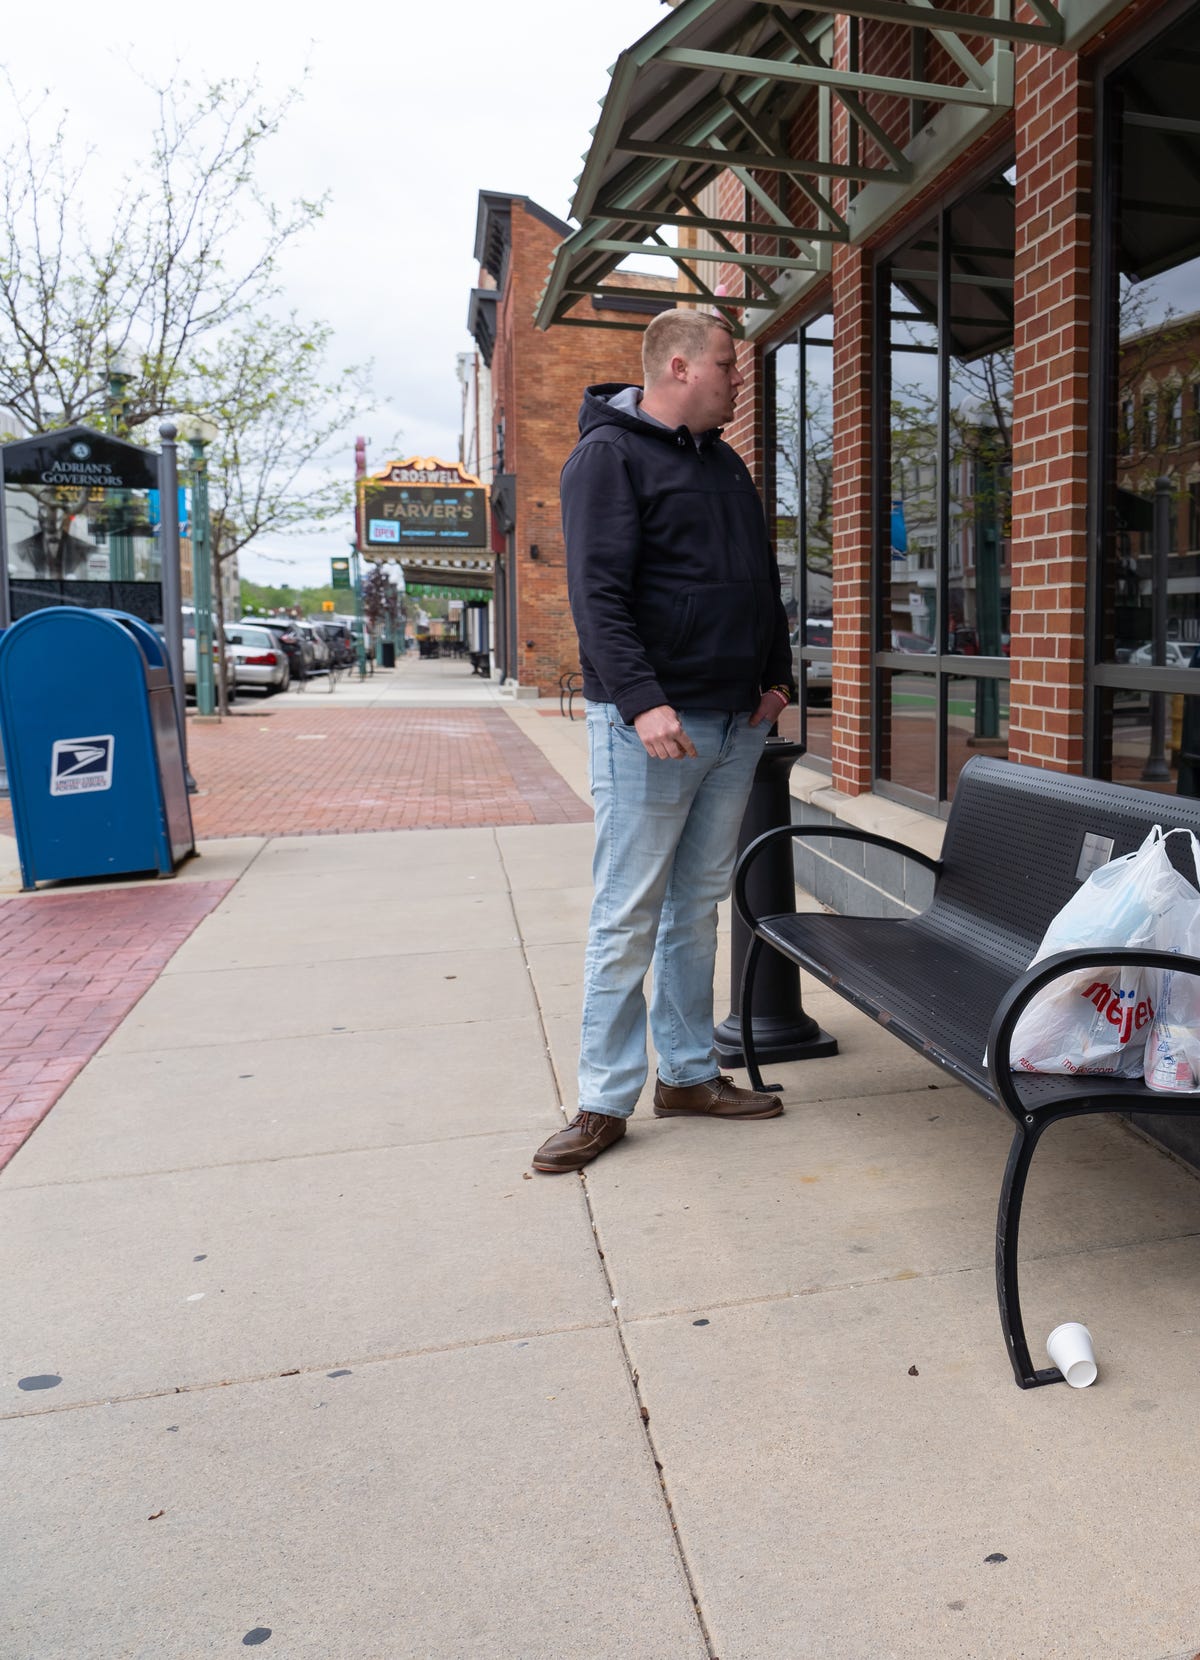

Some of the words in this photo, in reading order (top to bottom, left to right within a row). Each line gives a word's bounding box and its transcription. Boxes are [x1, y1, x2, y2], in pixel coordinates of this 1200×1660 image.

[51, 461, 112, 474] ADRIAN'S
[41, 472, 123, 486] GOVERNORS
[391, 469, 460, 483] CROSWELL
[383, 503, 474, 519] FARVER'S
